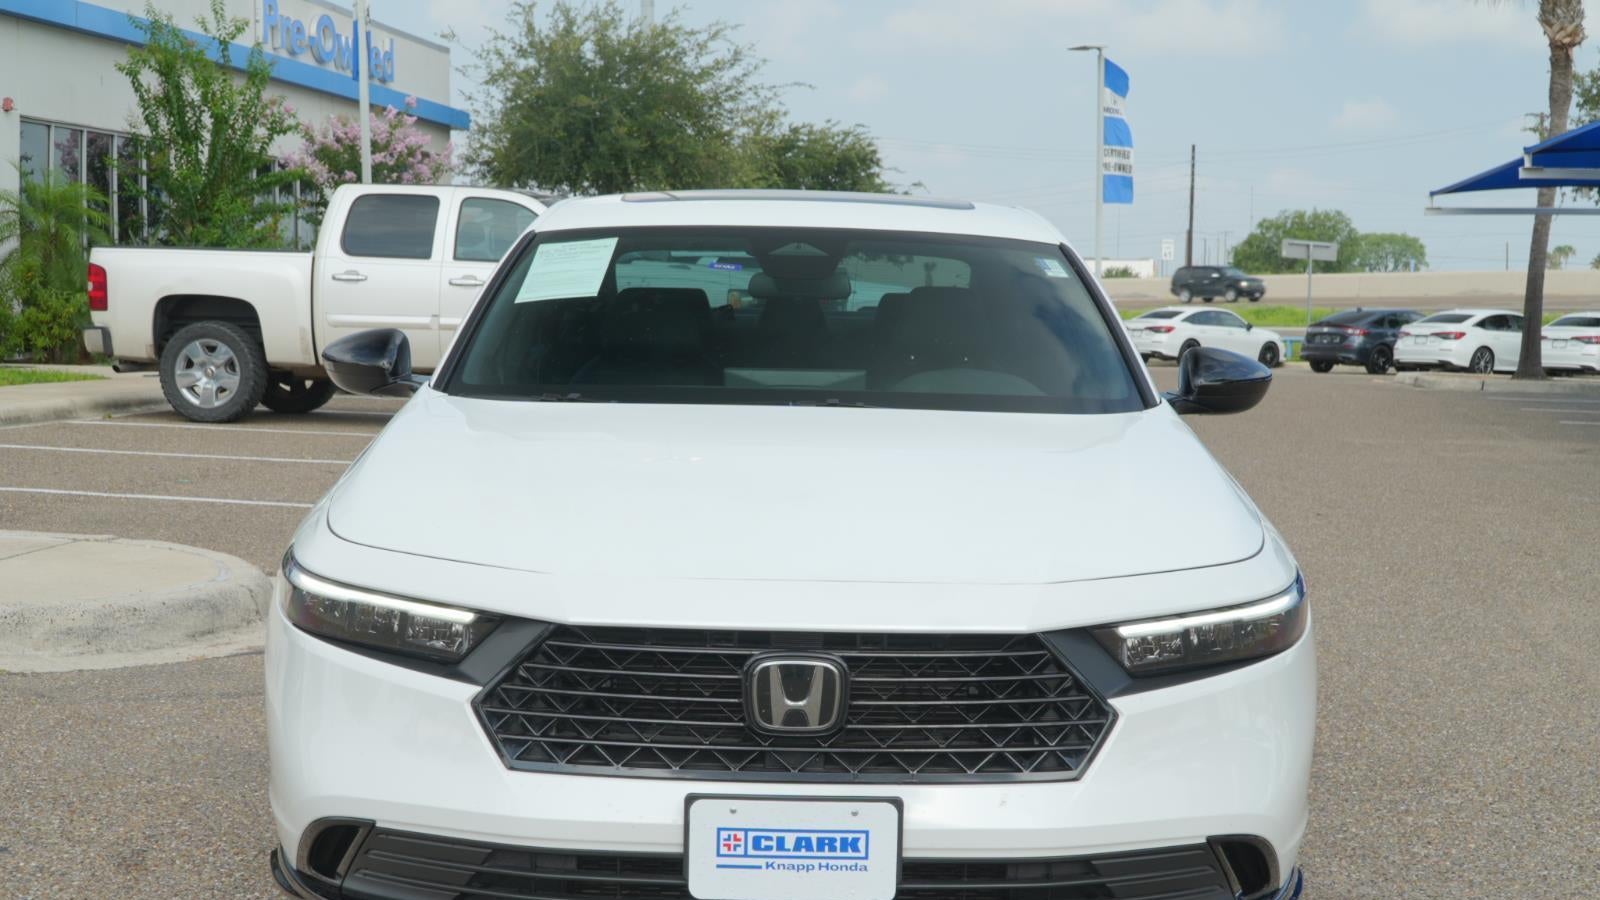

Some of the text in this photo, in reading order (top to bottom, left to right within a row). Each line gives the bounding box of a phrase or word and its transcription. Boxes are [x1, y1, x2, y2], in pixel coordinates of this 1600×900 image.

[262, 0, 394, 82] Pre-Owed
[751, 835, 861, 853] CLARK
[765, 861, 868, 873] Knapp Honda
